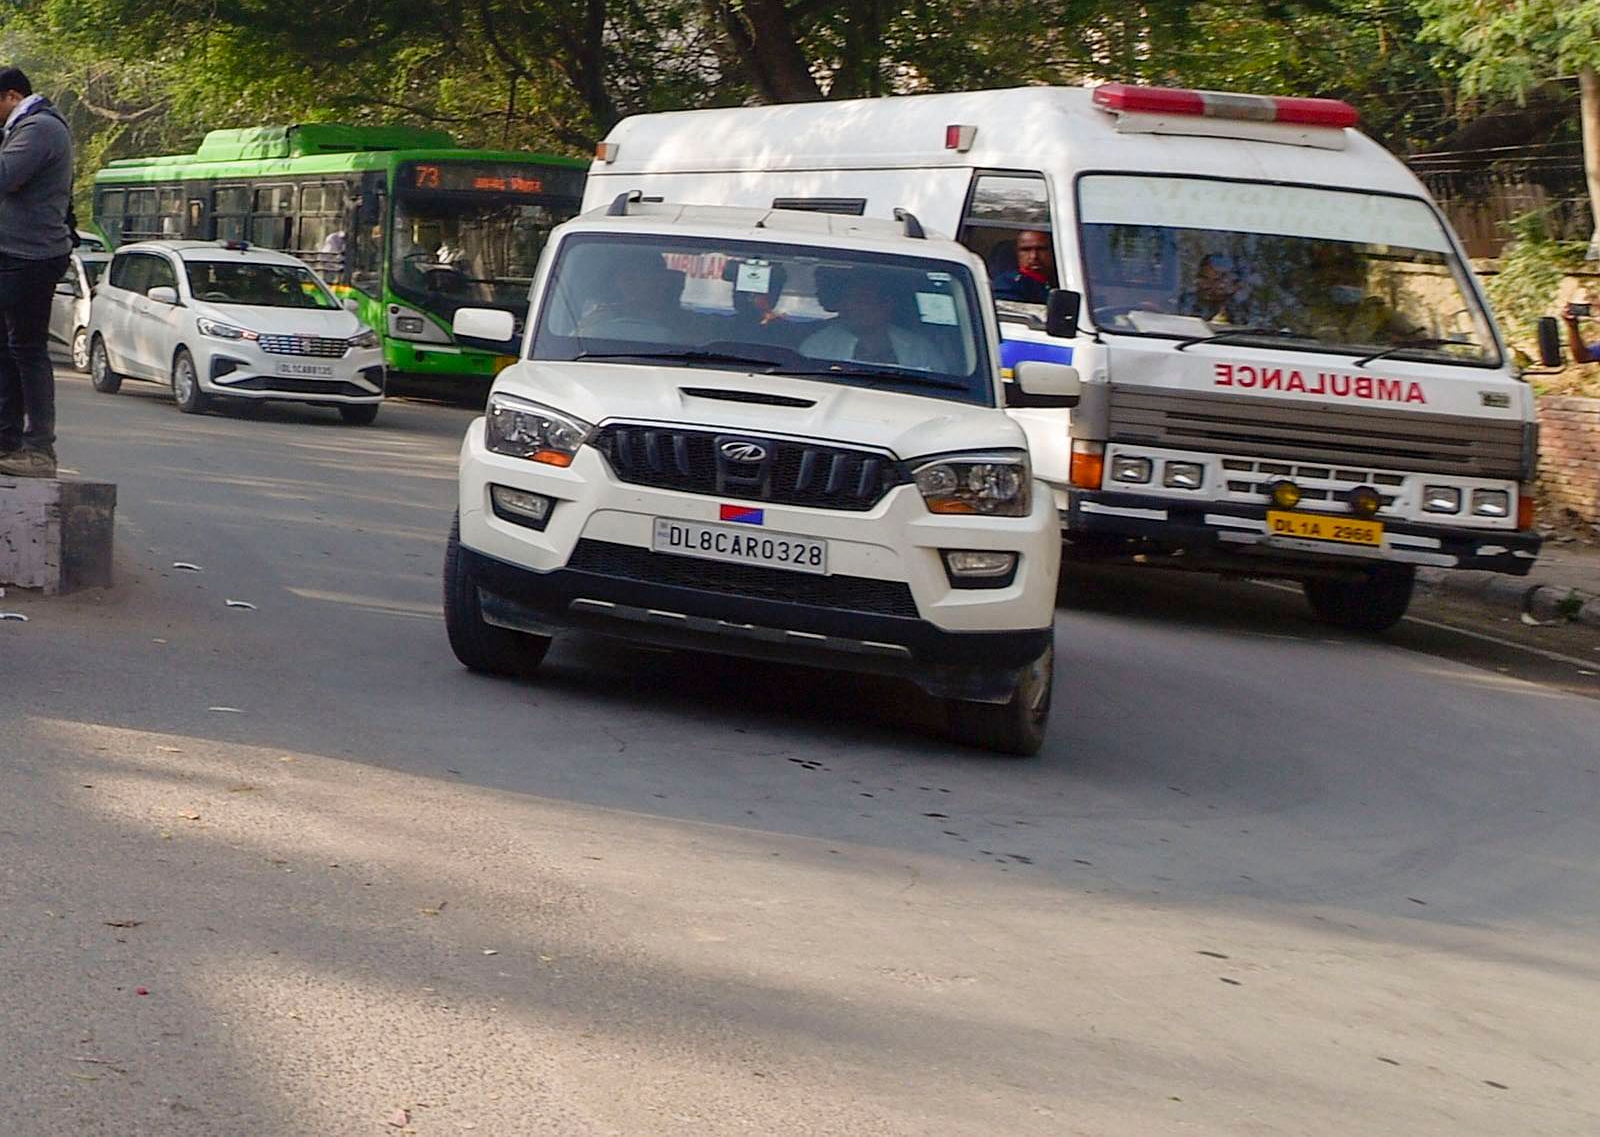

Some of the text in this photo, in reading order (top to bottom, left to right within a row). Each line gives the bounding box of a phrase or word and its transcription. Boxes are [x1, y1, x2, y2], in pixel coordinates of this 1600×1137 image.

[415, 164, 440, 188] 73
[1274, 519, 1294, 533] DL
[1302, 522, 1320, 536] 1A
[669, 526, 822, 566] DL8CAR0328
